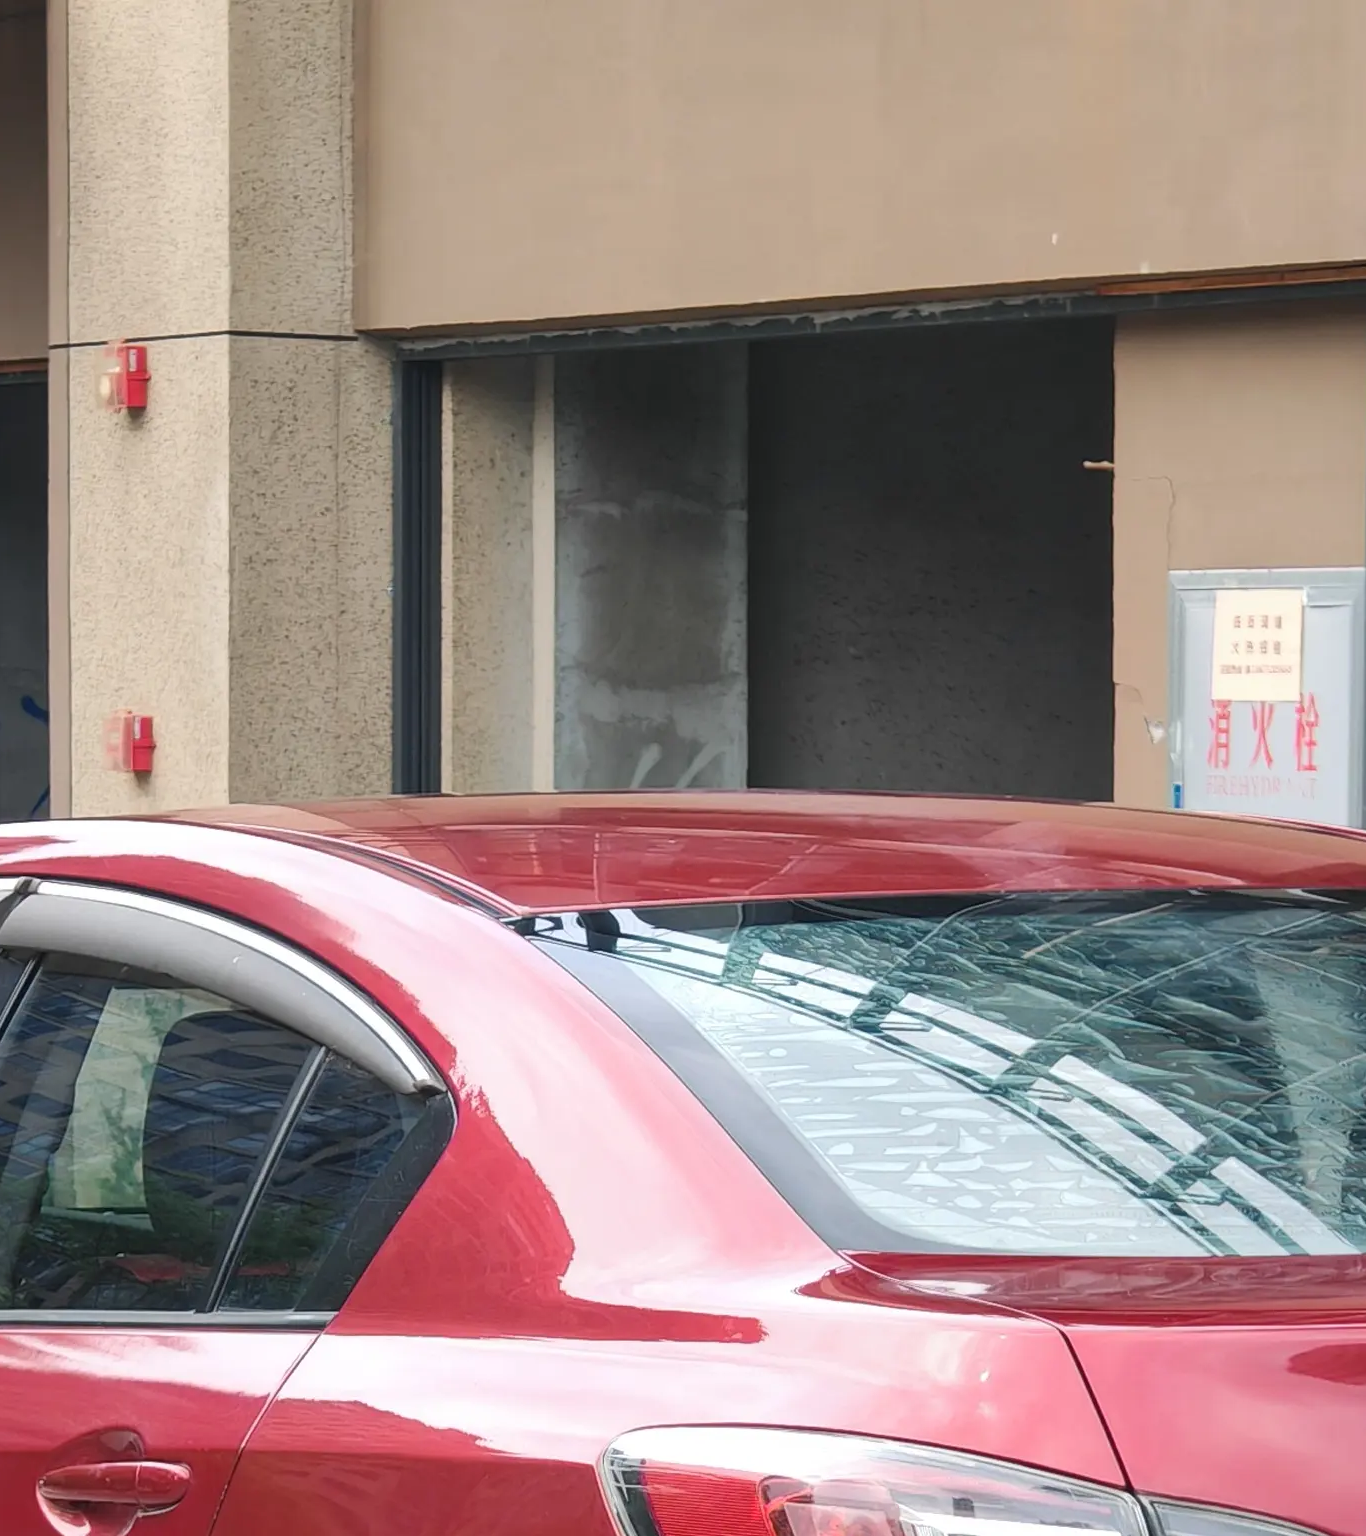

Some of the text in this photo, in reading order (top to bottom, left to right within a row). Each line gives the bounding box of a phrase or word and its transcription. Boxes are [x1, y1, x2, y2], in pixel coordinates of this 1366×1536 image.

[1206, 692, 1320, 772] 消火栓
[1206, 774, 1318, 800] FIREHYDRT
